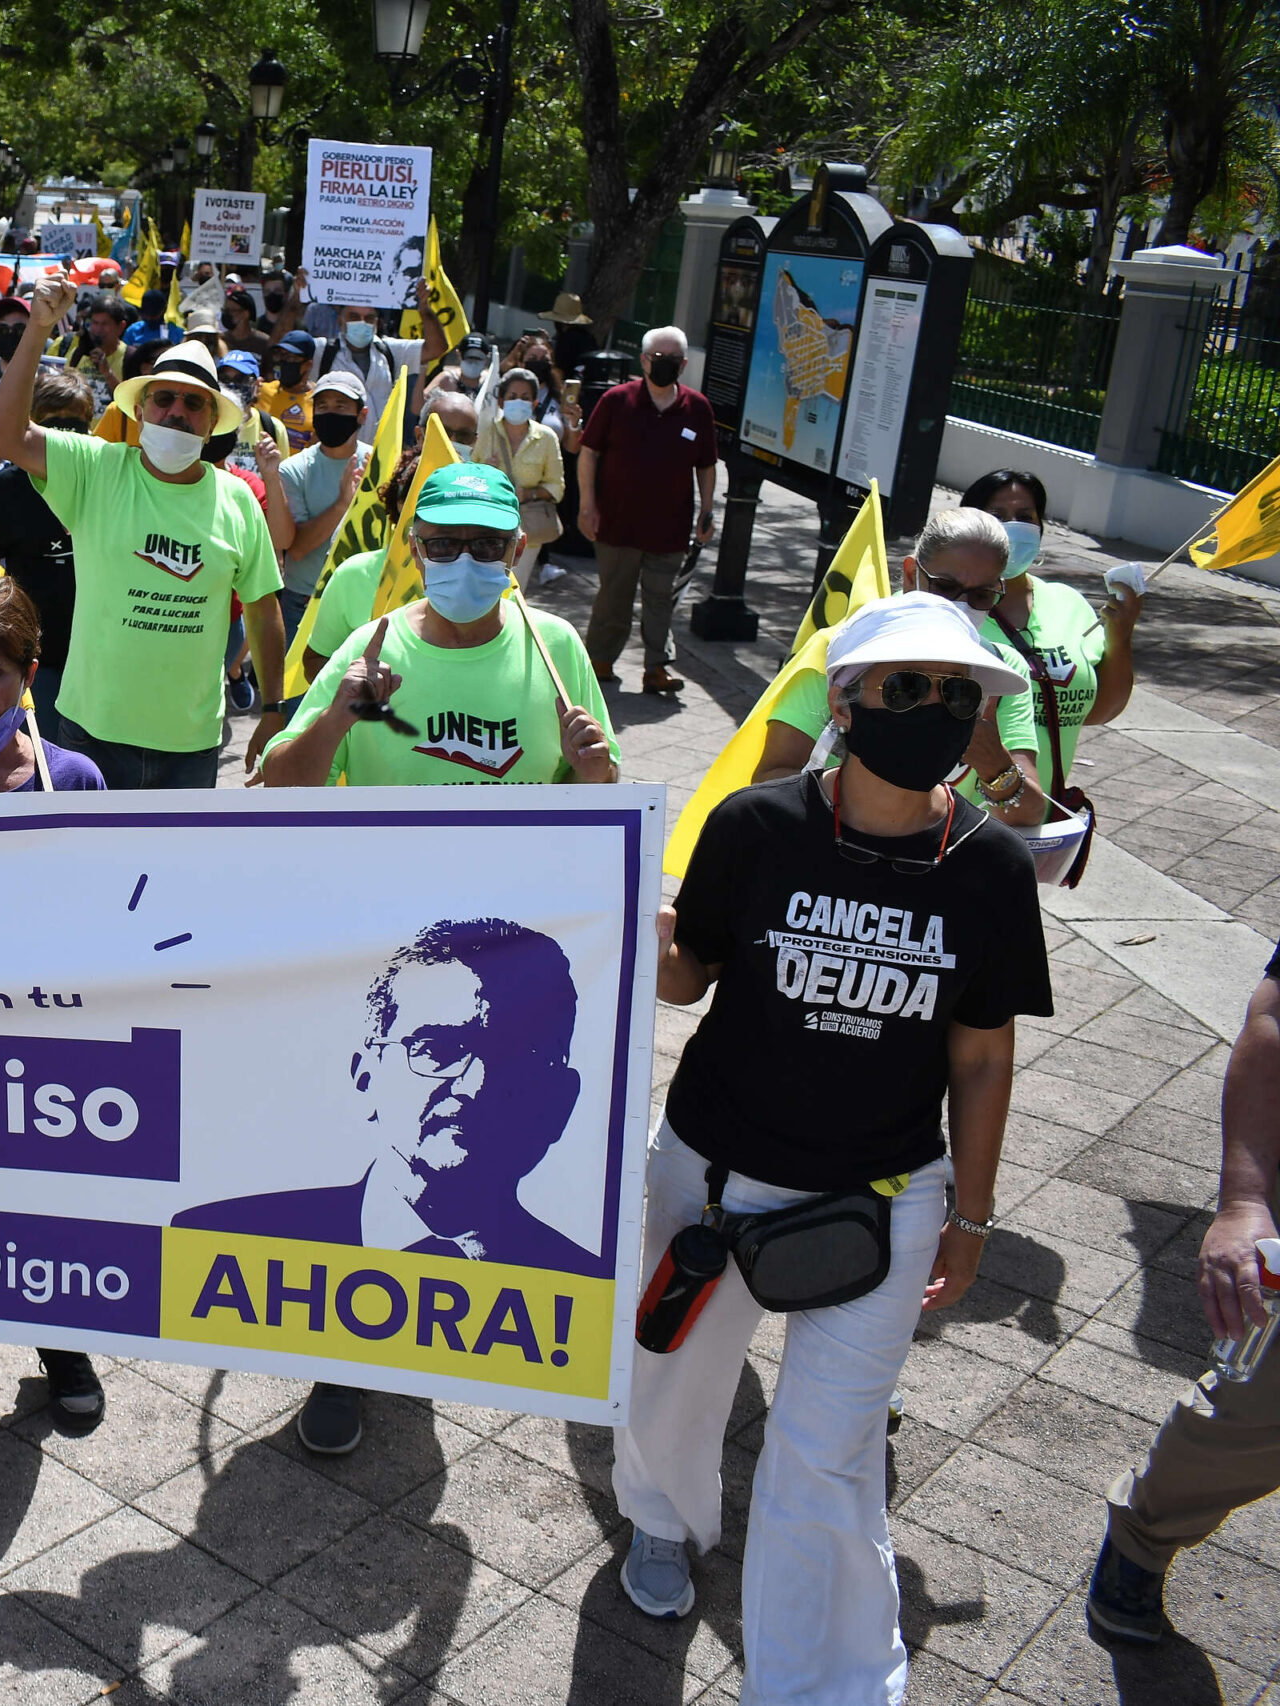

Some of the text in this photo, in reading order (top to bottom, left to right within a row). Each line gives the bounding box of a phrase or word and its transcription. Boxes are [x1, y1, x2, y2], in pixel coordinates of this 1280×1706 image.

[322, 151, 414, 166] GOBERNADOR PEDRO
[321, 160, 418, 187] PIERLUISI,
[320, 181, 418, 199] FIRMA LA LEY
[320, 195, 414, 210] PARA UN RETIRO DIGNO
[200, 221, 256, 234] Resolviste?
[320, 224, 343, 232] DONDE
[375, 228, 404, 236] PALABRA
[340, 216, 404, 228] PON LA ACCIÓN
[314, 247, 386, 261] MARCHA PA'
[314, 259, 382, 271] LA FORTALEZA
[359, 272, 382, 284] 2PM
[144, 533, 202, 565] UNETE
[128, 588, 149, 598] HAY
[150, 592, 172, 602] QUE
[132, 605, 201, 618] PARA LUCHAR
[122, 617, 128, 625] Y
[128, 618, 159, 632] LUCHAR
[158, 623, 178, 633] PARA
[426, 710, 519, 751] UNETE
[1027, 838, 1061, 848] Shield
[785, 891, 944, 954] CANCELA
[781, 935, 942, 965] PROTEGE PENSIONES
[776, 946, 939, 1021] DEUDA
[28, 985, 83, 1008] tu
[821, 1011, 883, 1030] CONSTRUYAMOS
[821, 1022, 880, 1040] OTRO ACUERDO
[190, 1253, 575, 1368] AHORA!
